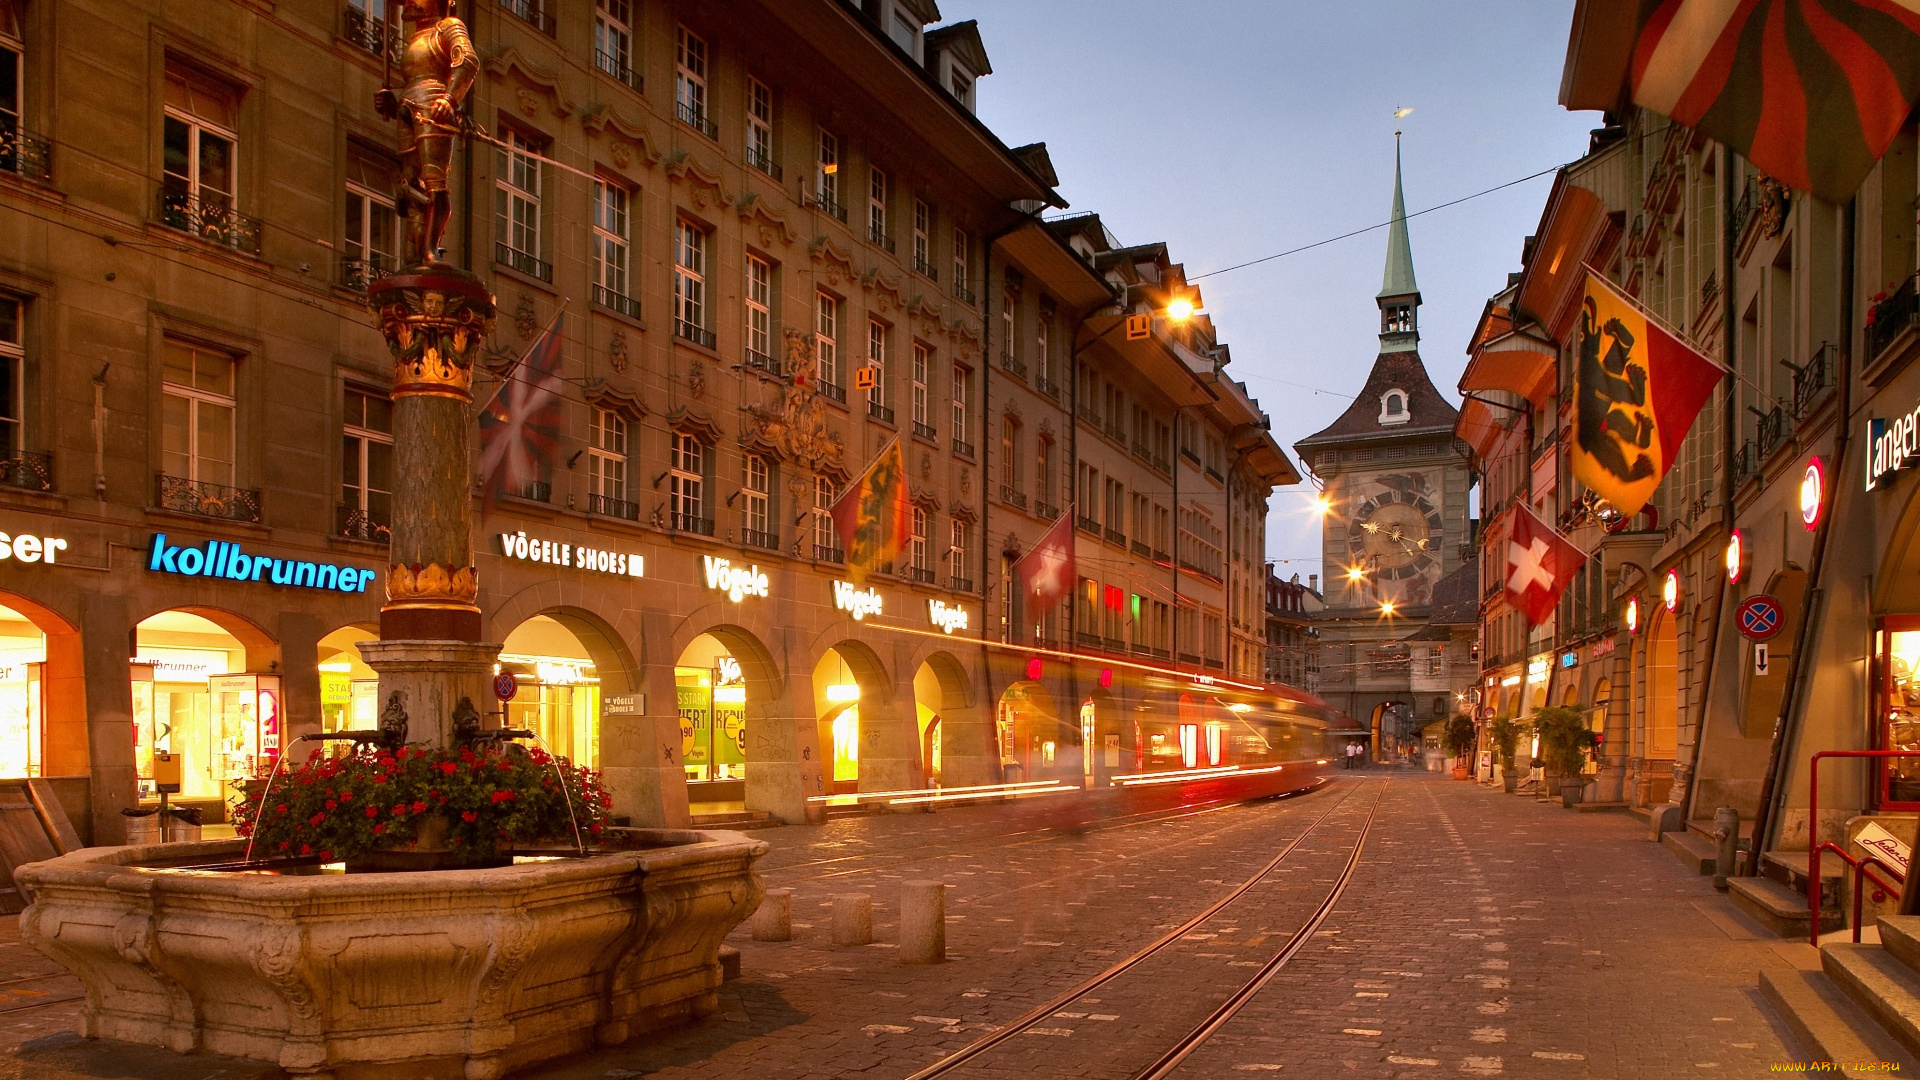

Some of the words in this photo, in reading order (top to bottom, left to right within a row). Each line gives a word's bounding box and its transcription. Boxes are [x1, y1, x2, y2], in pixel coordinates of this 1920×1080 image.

[151, 533, 376, 593] kollbrunner
[576, 546, 627, 575] SHOES
[703, 554, 769, 603] Vögele
[834, 579, 882, 621] Vögele
[929, 599, 968, 635] Vögele
